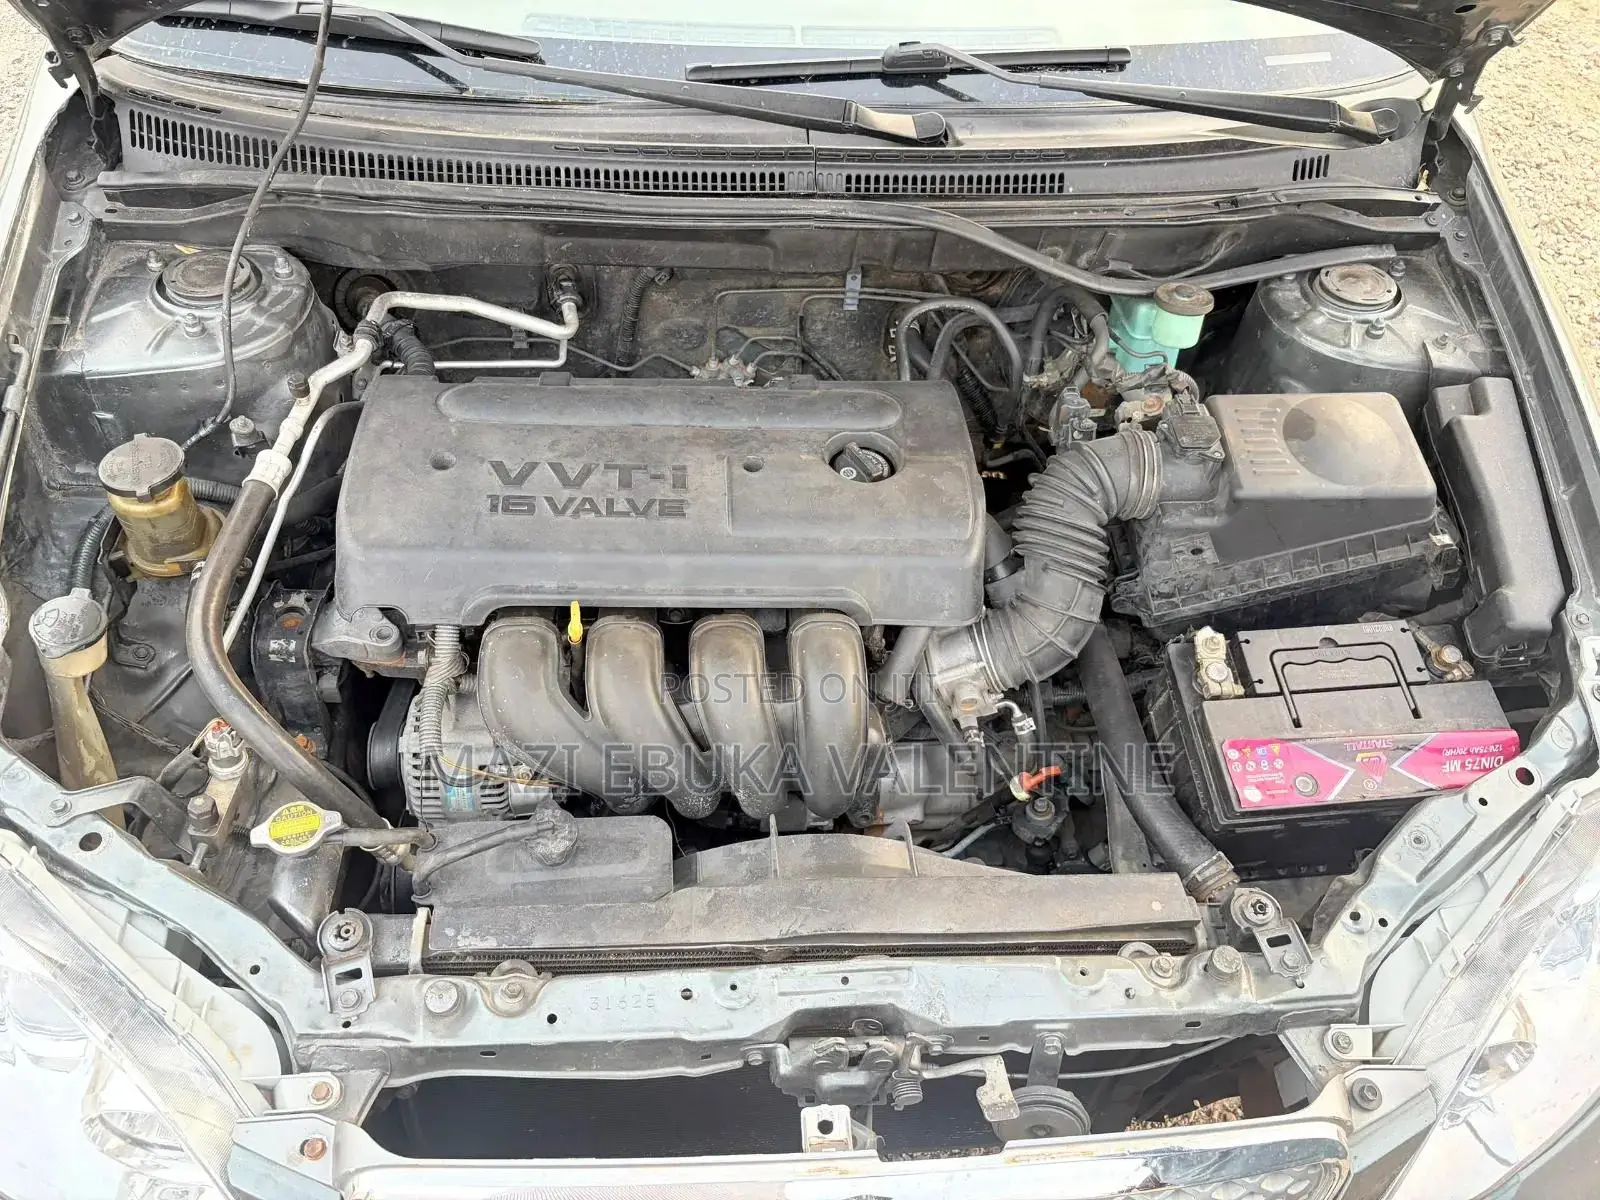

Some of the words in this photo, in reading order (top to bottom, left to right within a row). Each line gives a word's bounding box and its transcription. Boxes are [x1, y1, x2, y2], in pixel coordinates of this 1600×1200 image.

[486, 494, 537, 516] 16
[542, 496, 688, 518] VALVE
[1343, 738, 1393, 752] STARTALL
[1441, 759, 1462, 773] MF
[1464, 755, 1504, 771] DIN75
